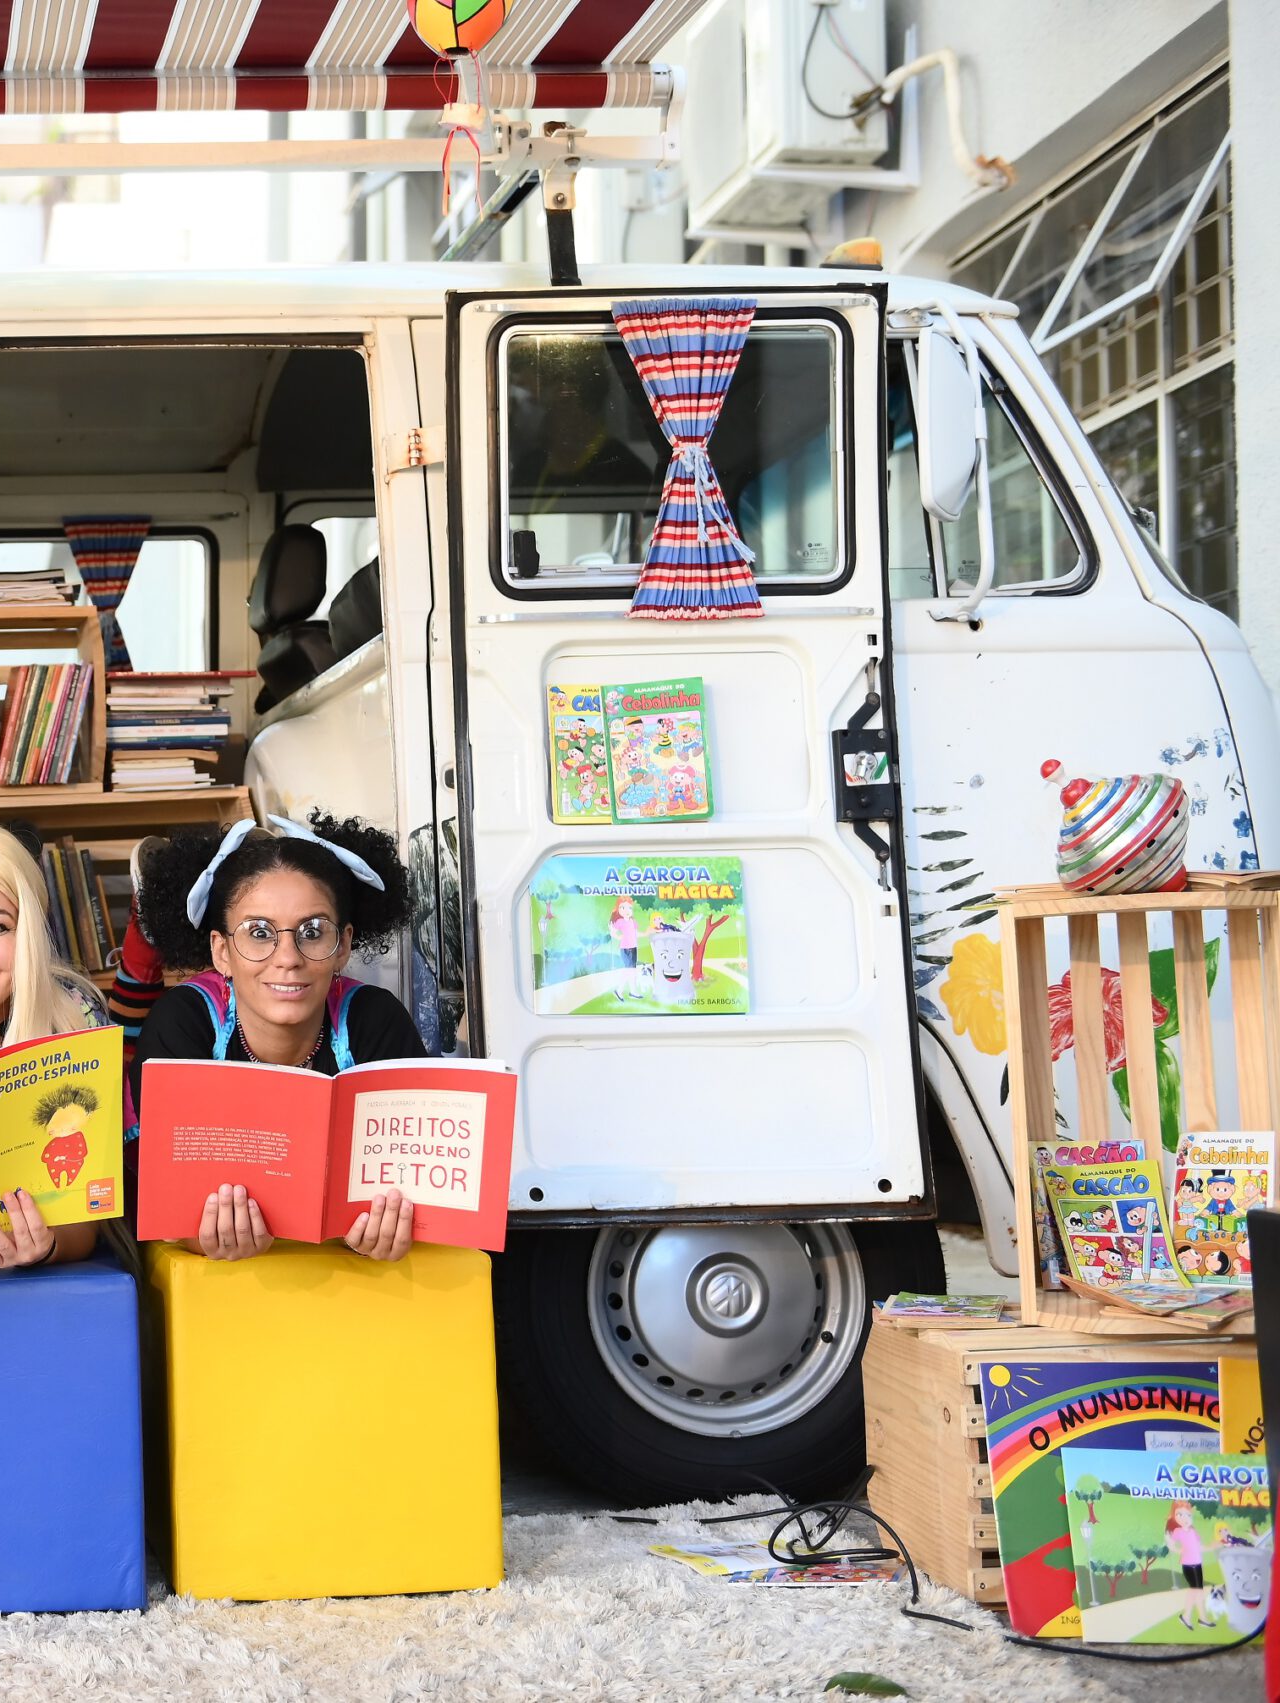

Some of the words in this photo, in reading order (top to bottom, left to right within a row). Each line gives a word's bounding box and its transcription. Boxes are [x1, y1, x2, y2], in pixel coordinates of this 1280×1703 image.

[633, 685, 673, 694] ALMANAQUE
[621, 690, 701, 712] Cebolinha
[605, 867, 619, 882] A
[625, 867, 711, 882] GAROTA
[583, 886, 600, 895] DA
[604, 885, 656, 895] LATINHA
[658, 883, 736, 900] MÁGICA
[40, 1050, 72, 1067] VIRA
[366, 1116, 471, 1140] DIREITOS
[363, 1143, 383, 1155] DO
[389, 1143, 471, 1160] PEQUENO
[1054, 1143, 1138, 1166] CASCÃO
[1189, 1145, 1269, 1165] Cebolinha
[1080, 1168, 1123, 1177] ALMANAQUE
[1072, 1174, 1150, 1196] CASCÃO
[1028, 1426, 1050, 1451] O
[1156, 1464, 1174, 1483] A
[1180, 1464, 1268, 1485] GAROT
[1131, 1487, 1151, 1497] DA
[1155, 1488, 1217, 1501] LATINHA
